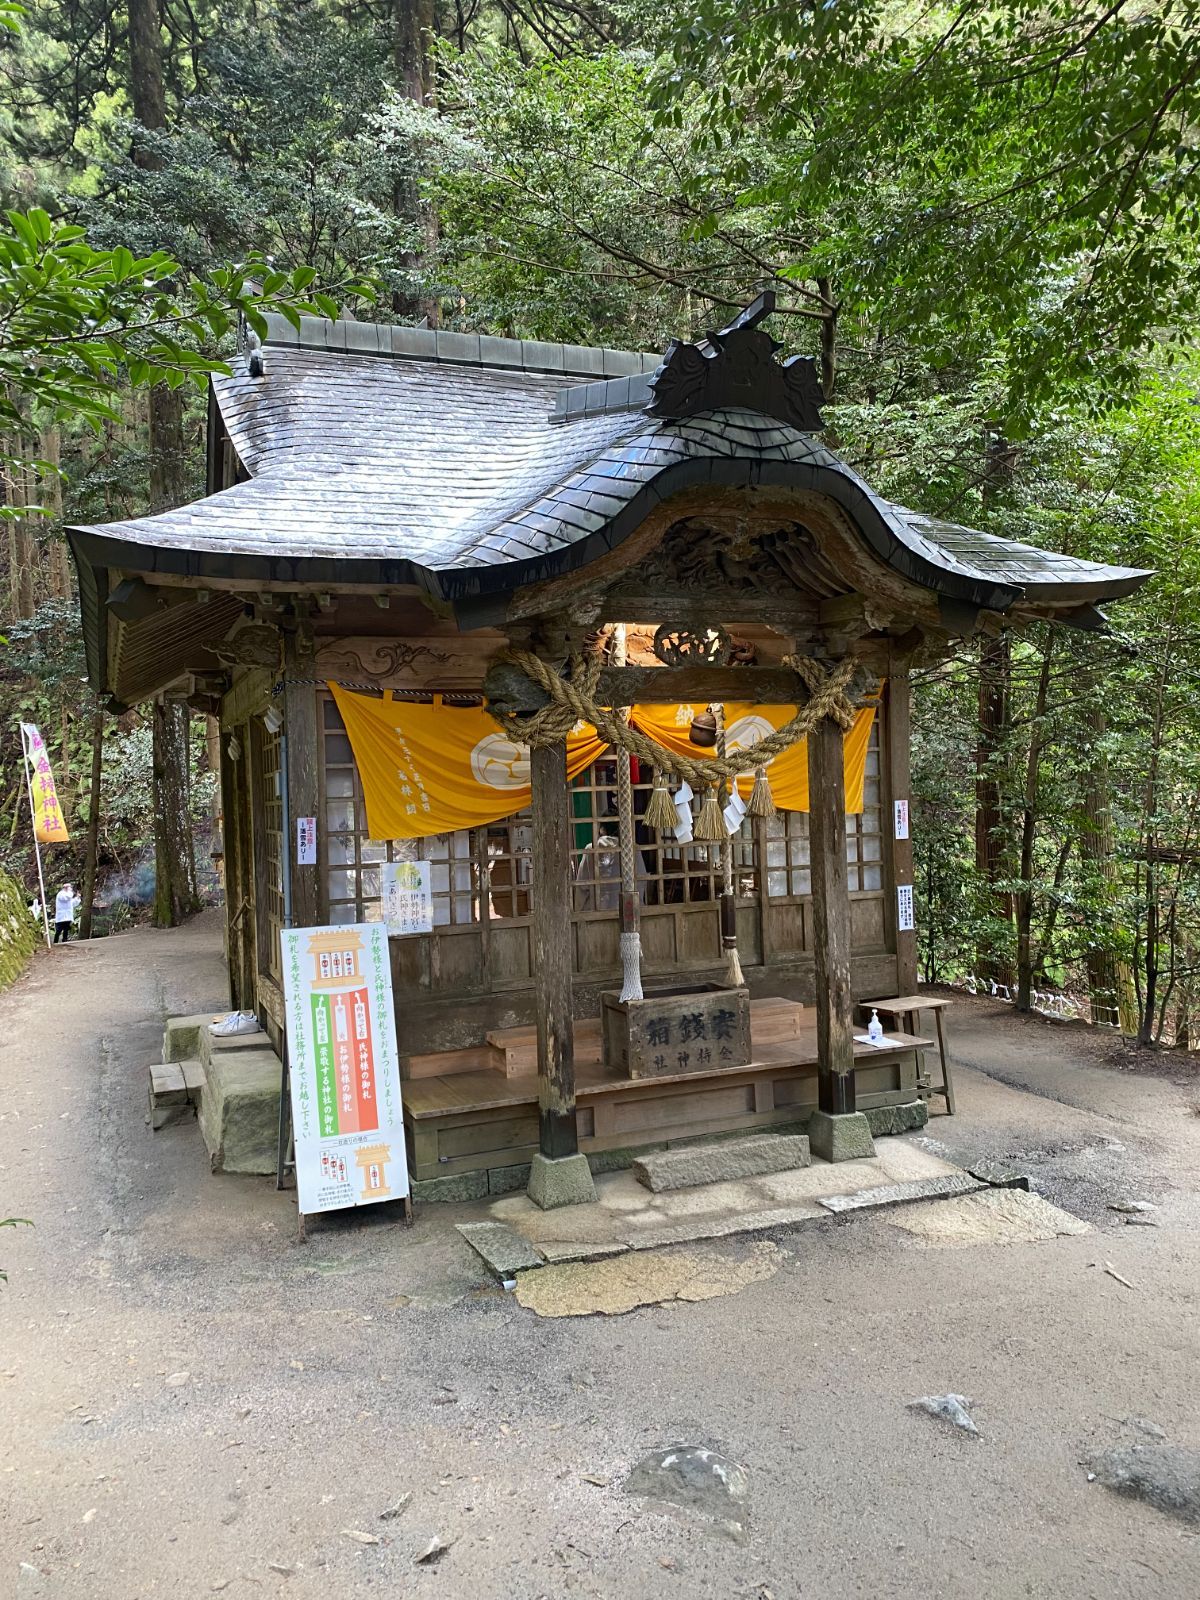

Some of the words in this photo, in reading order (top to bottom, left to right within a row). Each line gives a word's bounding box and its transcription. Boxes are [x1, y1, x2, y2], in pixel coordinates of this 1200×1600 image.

[36, 756, 62, 833] 金持神社
[287, 934, 310, 1139] 御札を希望される方は社務所までお越し下さい
[371, 927, 394, 1128] お伊勢様と氏神様の御札をおまつりしましょう
[319, 1046, 335, 1135] 崇敬する神社の御札
[338, 1044, 353, 1113] お伊勢様の御札
[358, 1041, 372, 1101] 氏神様の御札
